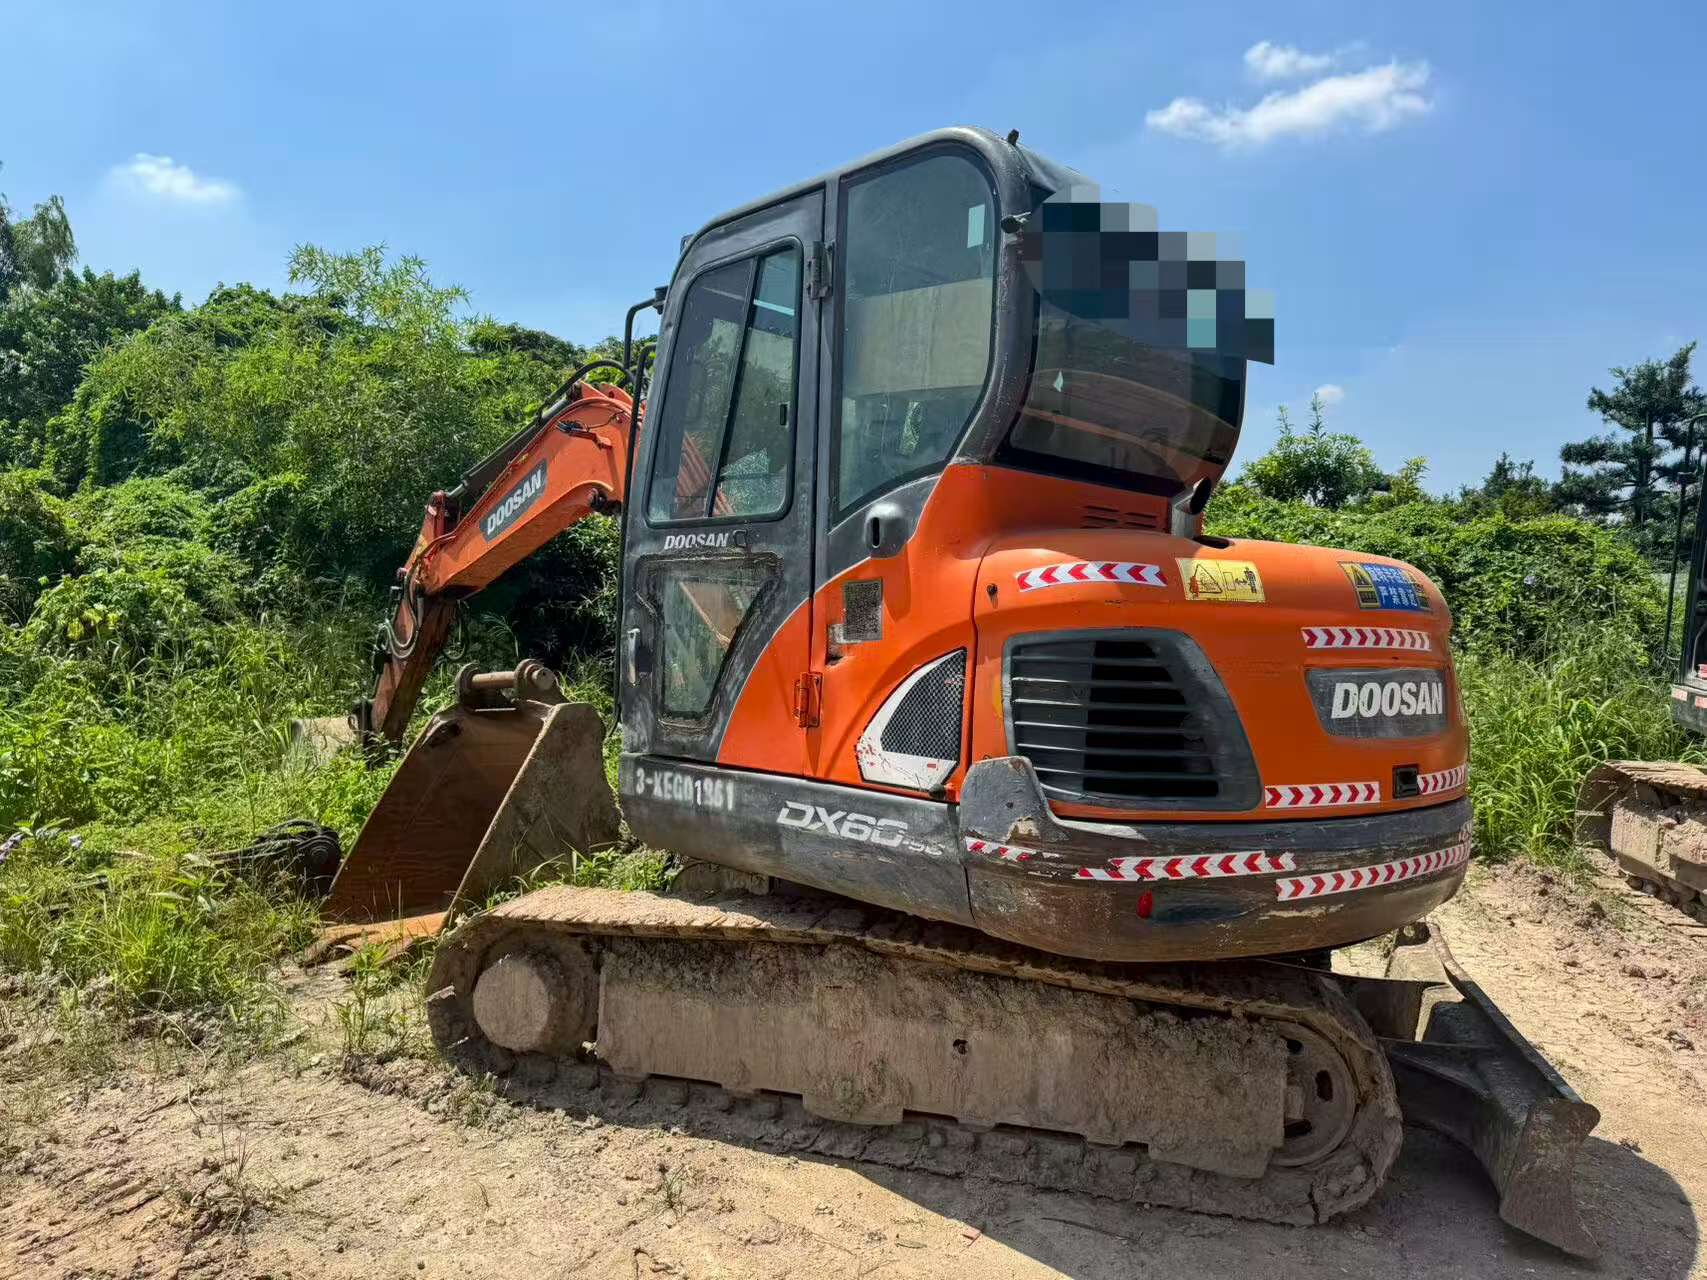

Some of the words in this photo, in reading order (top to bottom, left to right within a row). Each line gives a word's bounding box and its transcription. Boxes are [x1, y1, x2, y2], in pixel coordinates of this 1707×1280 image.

[487, 469, 541, 535] DOOSAN
[664, 533, 729, 550] DOOSAN
[1331, 681, 1443, 719] DOOSAN
